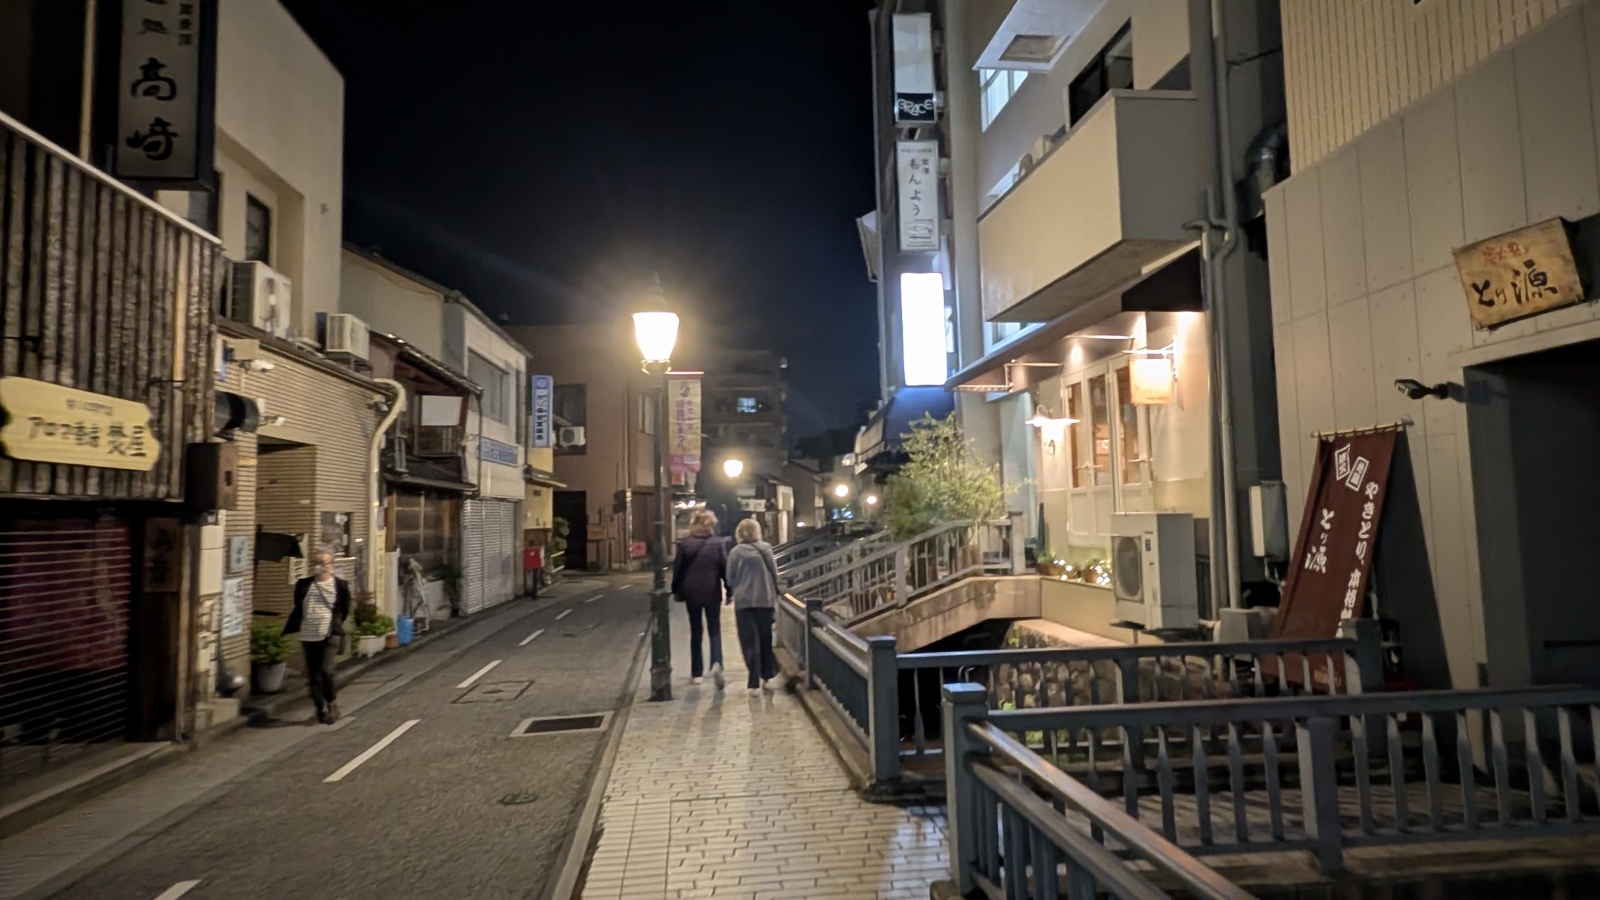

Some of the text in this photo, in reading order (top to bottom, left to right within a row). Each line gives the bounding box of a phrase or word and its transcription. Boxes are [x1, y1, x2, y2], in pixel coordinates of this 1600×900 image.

[897, 98, 933, 117] GRACE
[909, 157, 922, 216] もんよう
[1471, 259, 1559, 307] とり源
[1304, 508, 1334, 574] とり源
